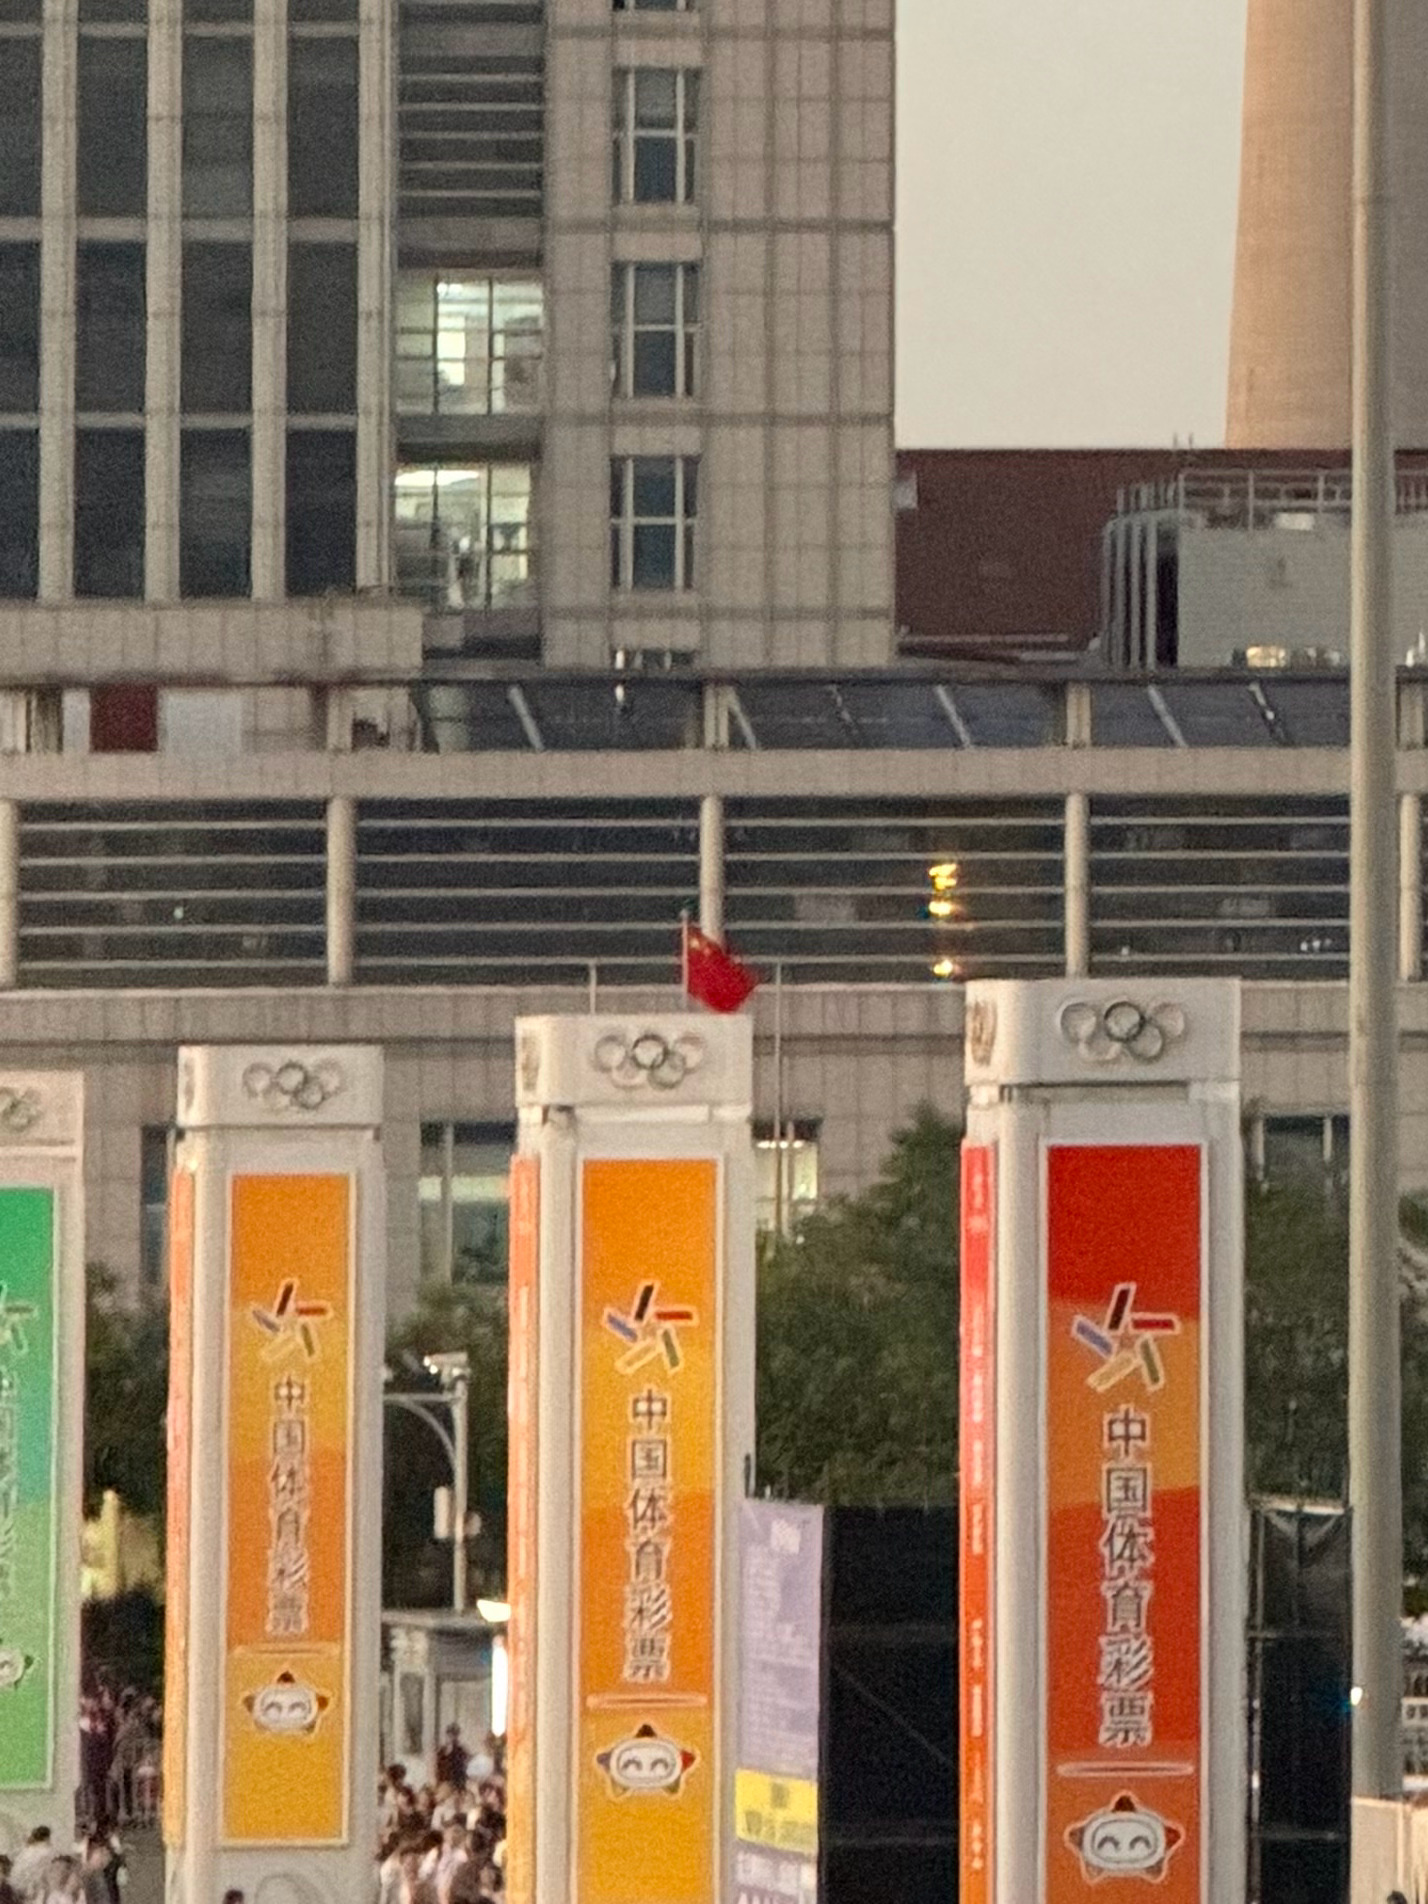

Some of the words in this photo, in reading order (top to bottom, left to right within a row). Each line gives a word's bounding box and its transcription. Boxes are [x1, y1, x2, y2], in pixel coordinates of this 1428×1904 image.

[625, 1386, 671, 1682] 中国体育彩票
[1099, 1404, 1154, 1746] 中国体育彩票
